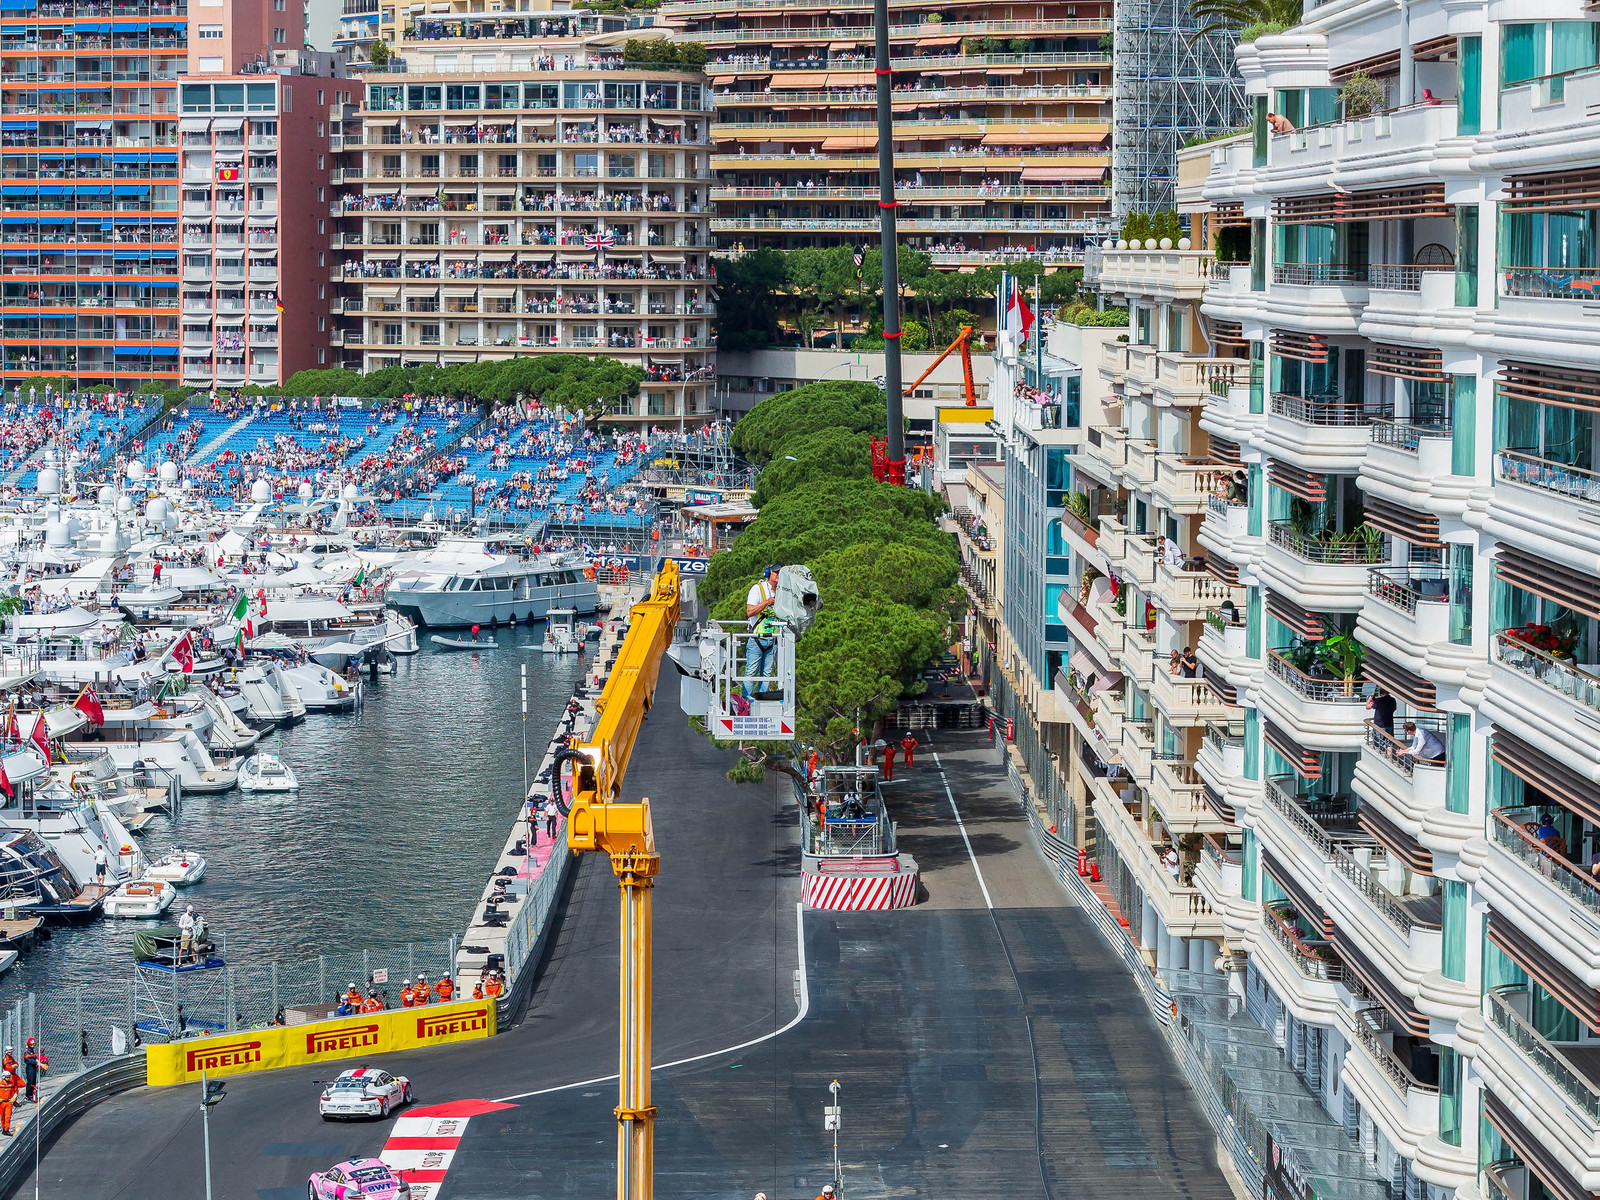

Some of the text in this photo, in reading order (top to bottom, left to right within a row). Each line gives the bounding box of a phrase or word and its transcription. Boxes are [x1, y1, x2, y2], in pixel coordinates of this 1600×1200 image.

[416, 1009, 488, 1038] PIRELLI
[306, 1024, 379, 1054] PIRELLI
[186, 1040, 261, 1072] PIRELLI
[367, 1183, 391, 1192] BWT
